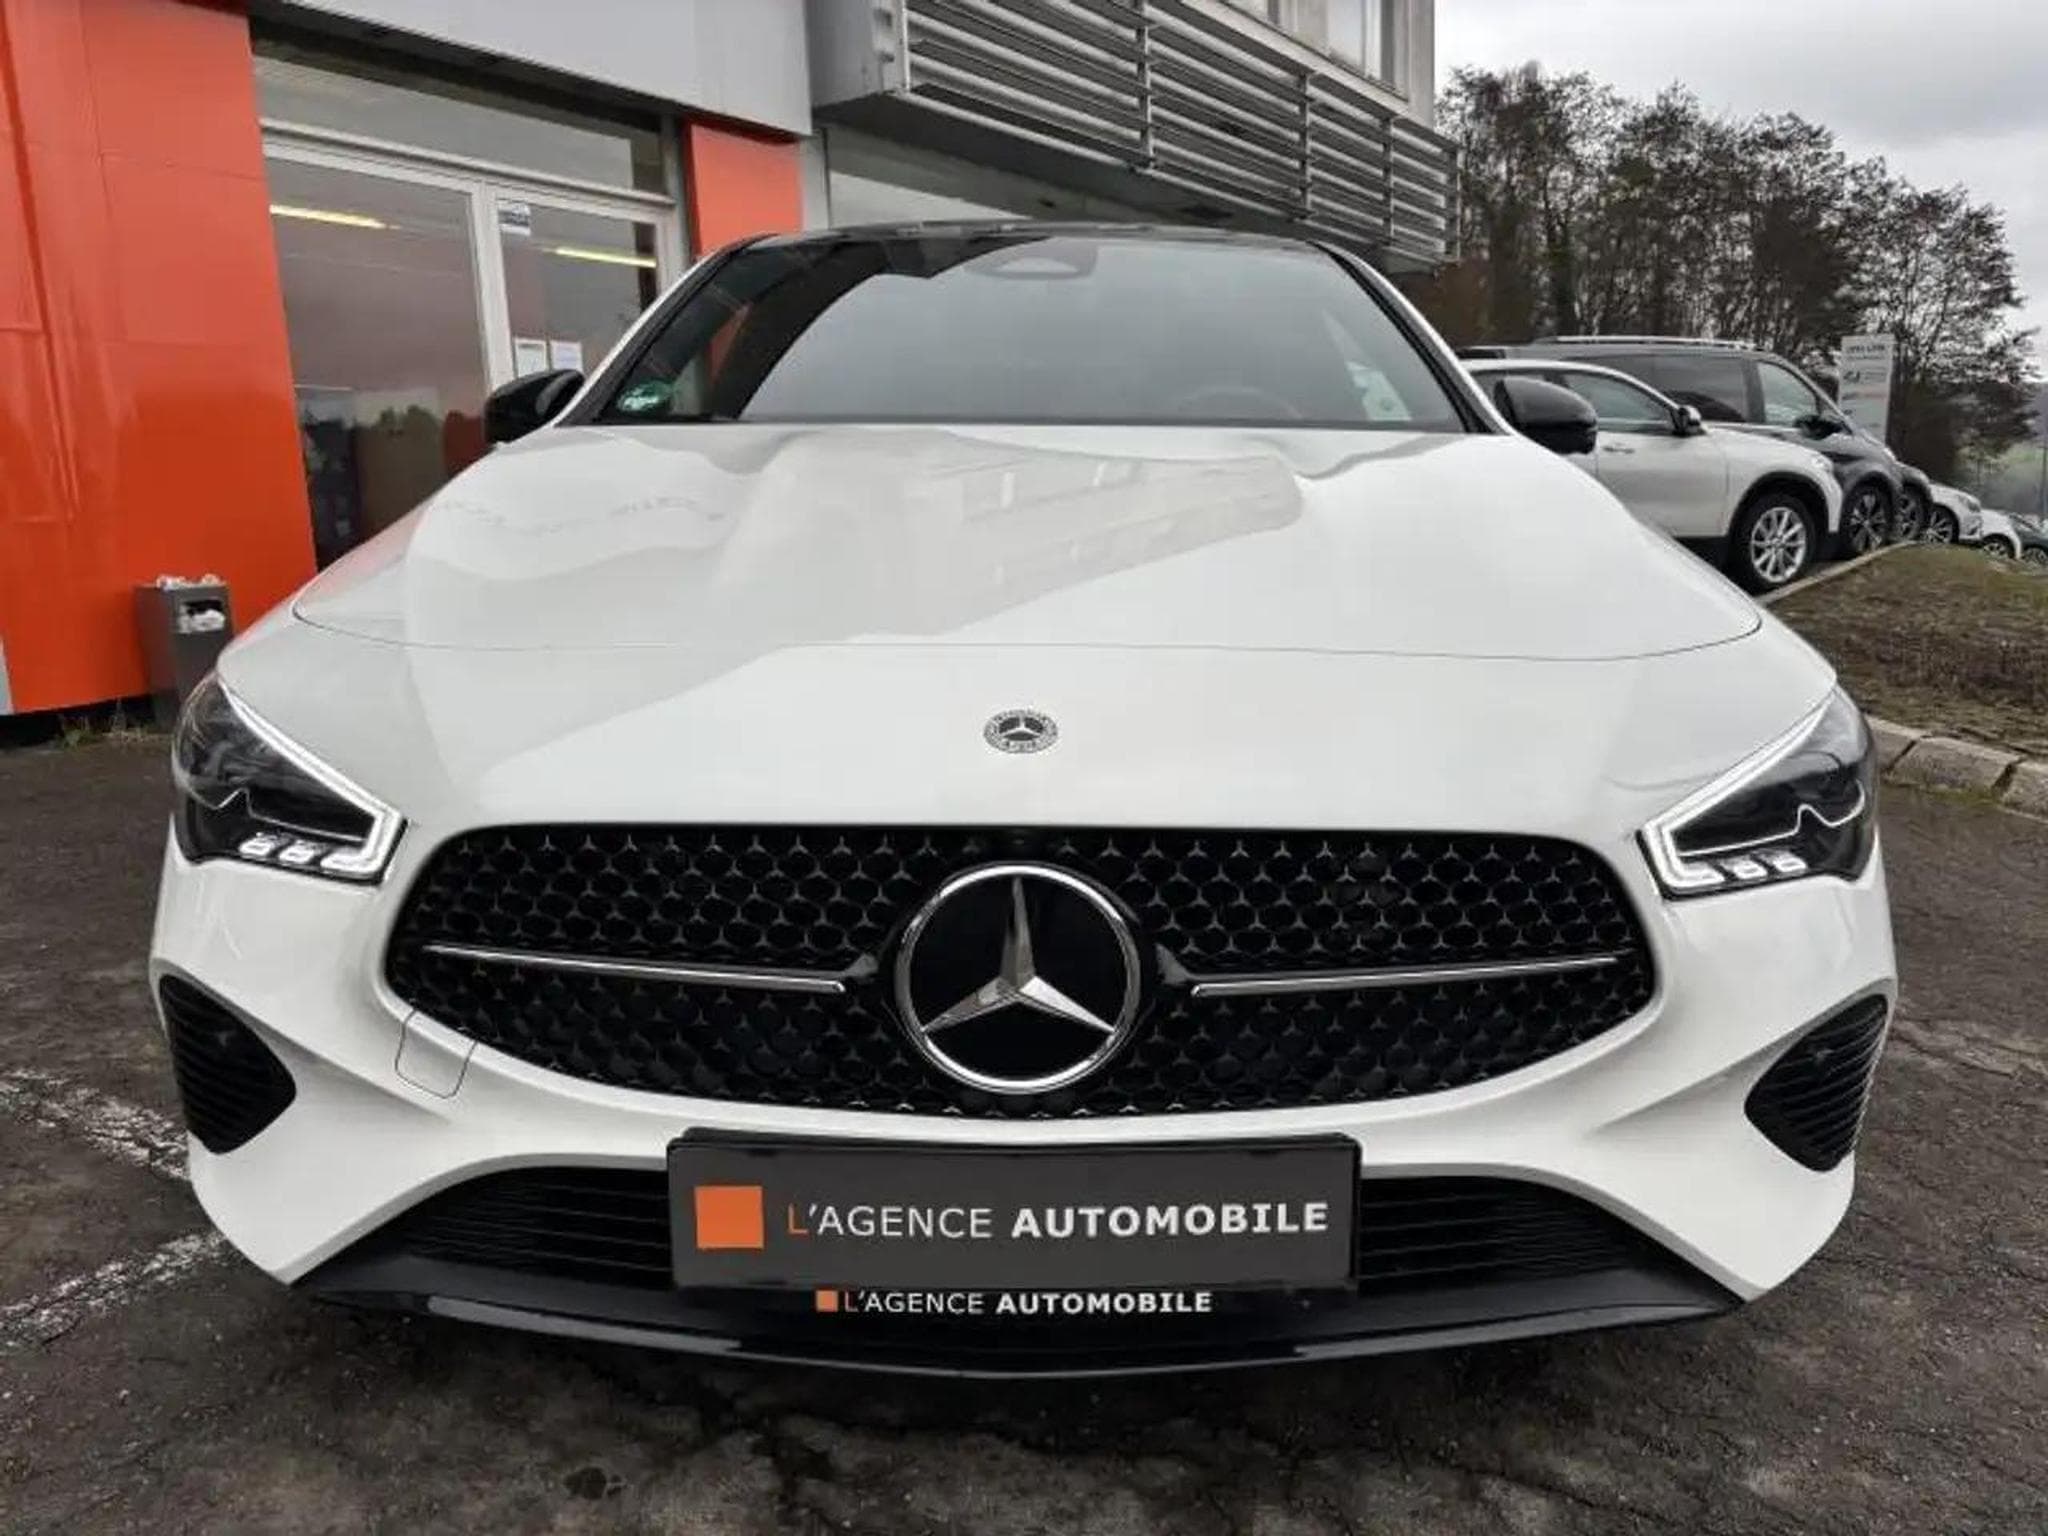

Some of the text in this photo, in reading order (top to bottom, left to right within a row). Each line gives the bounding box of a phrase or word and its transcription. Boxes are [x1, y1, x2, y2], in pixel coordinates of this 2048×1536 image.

[788, 1202, 1329, 1239] L'AGENCE AUTOMOBILE
[844, 1290, 1213, 1315] L'AGENCE AUTOMOBILE
